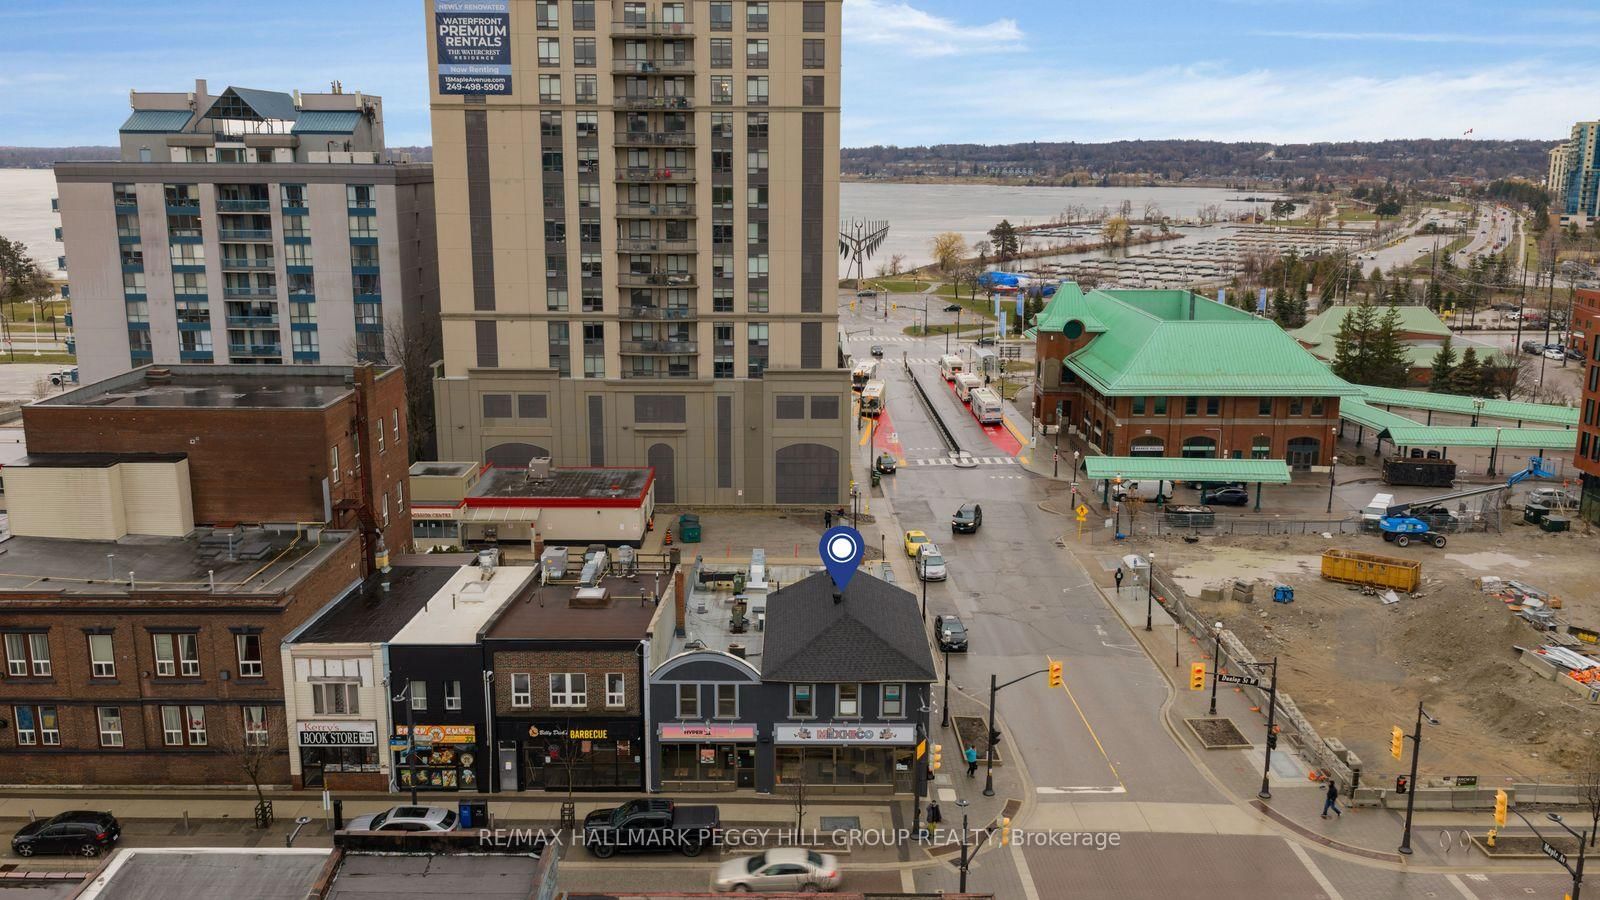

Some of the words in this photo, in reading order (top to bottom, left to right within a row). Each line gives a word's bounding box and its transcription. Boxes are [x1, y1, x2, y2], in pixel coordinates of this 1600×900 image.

[443, 17, 502, 25] WATERFRONT
[440, 25, 506, 37] PREMIUM
[445, 36, 502, 47] RENTALS
[469, 66, 499, 74] Renting
[304, 722, 340, 733] Kerry's
[303, 732, 330, 744] BOOK
[330, 732, 359, 744] STORE
[570, 729, 608, 739] BARBECUE
